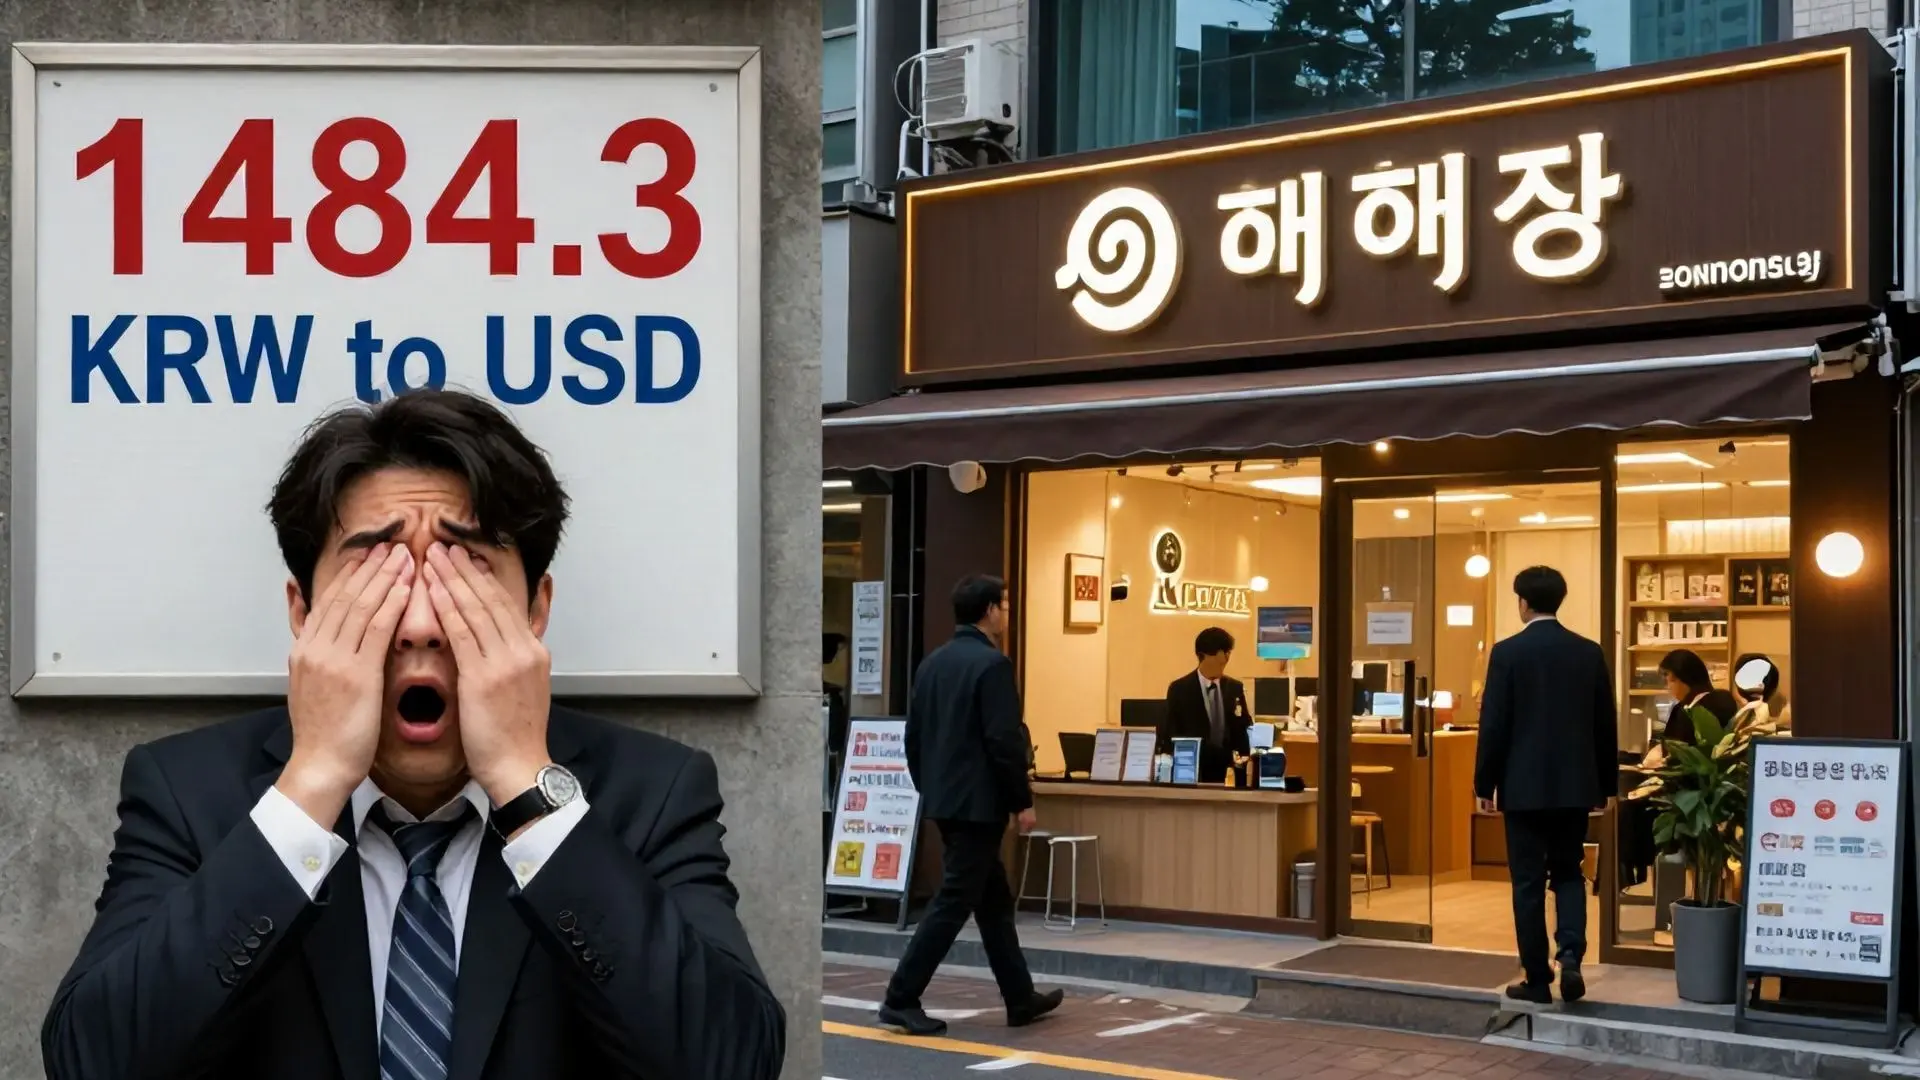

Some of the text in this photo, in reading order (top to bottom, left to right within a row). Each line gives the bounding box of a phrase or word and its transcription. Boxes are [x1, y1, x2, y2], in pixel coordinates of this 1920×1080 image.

[76, 117, 702, 279] 1484.3
[71, 314, 702, 405] KRW to USD
